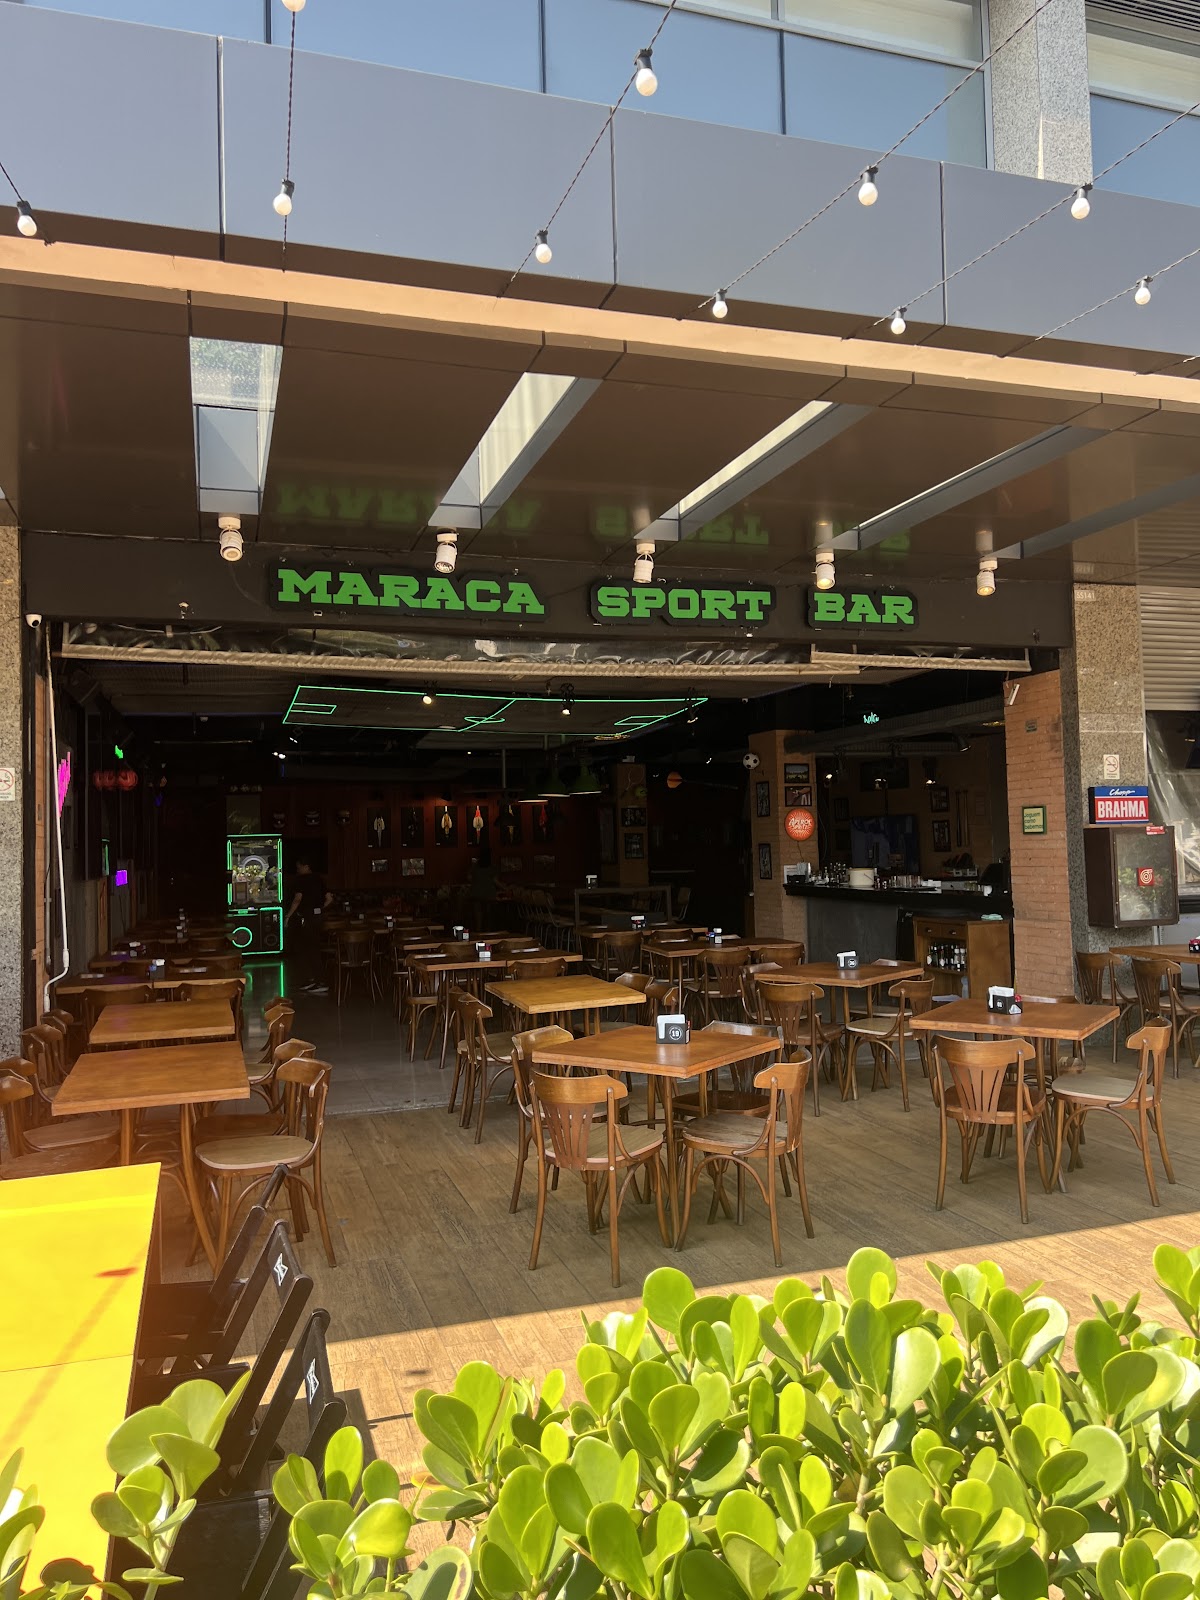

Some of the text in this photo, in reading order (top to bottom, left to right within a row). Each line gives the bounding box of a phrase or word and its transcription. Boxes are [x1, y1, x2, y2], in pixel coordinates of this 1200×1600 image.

[277, 568, 914, 624] MARACA SPORT BAR
[1097, 800, 1147, 818] BRAHMA
